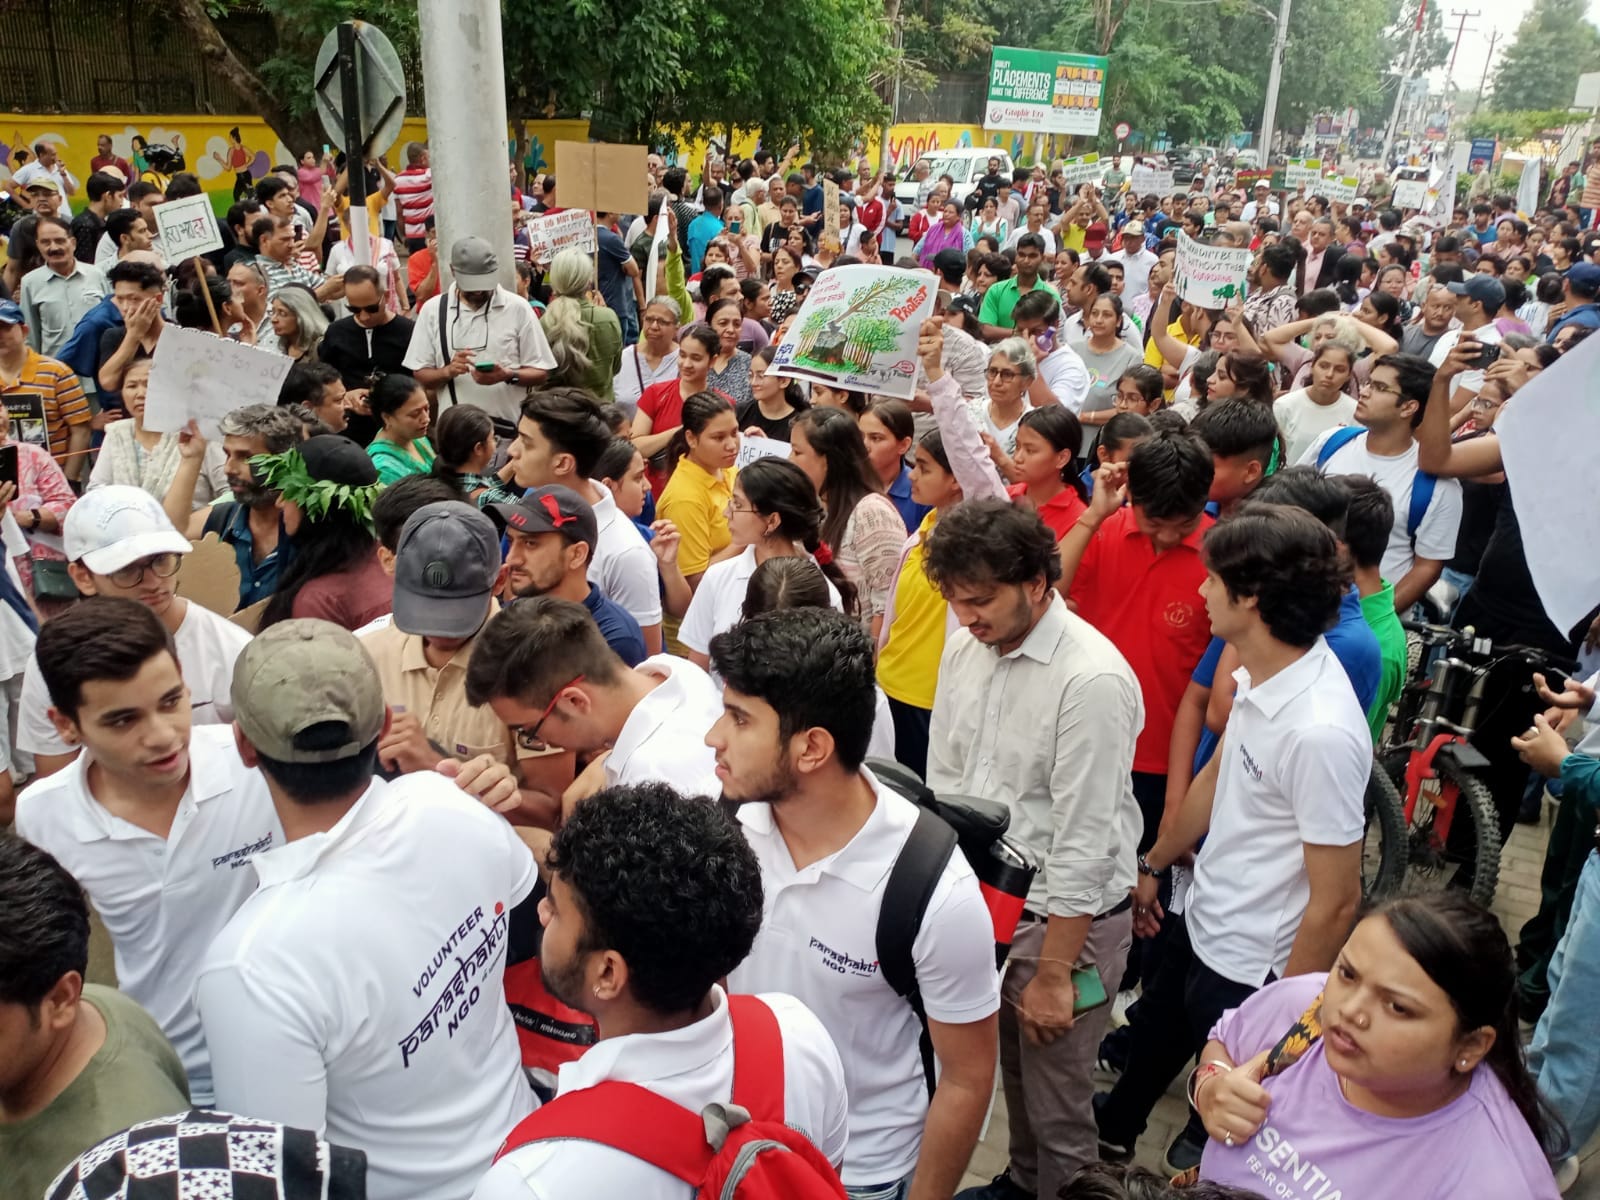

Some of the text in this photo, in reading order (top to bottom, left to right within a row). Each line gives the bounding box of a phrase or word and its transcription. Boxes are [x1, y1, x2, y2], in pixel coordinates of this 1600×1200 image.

[992, 68, 1051, 90] PLACEMENTS
[1012, 87, 1049, 101] DIFFERENCE
[889, 284, 928, 323] PROTEST
[412, 905, 485, 999] VOLUNTEER
[808, 935, 880, 974] parashakti
[821, 957, 846, 974] NGO
[398, 901, 508, 1069] parashakti
[446, 985, 481, 1040] NGO
[1246, 1154, 1277, 1187] FEAR
[1255, 1125, 1343, 1200] SENTIA
